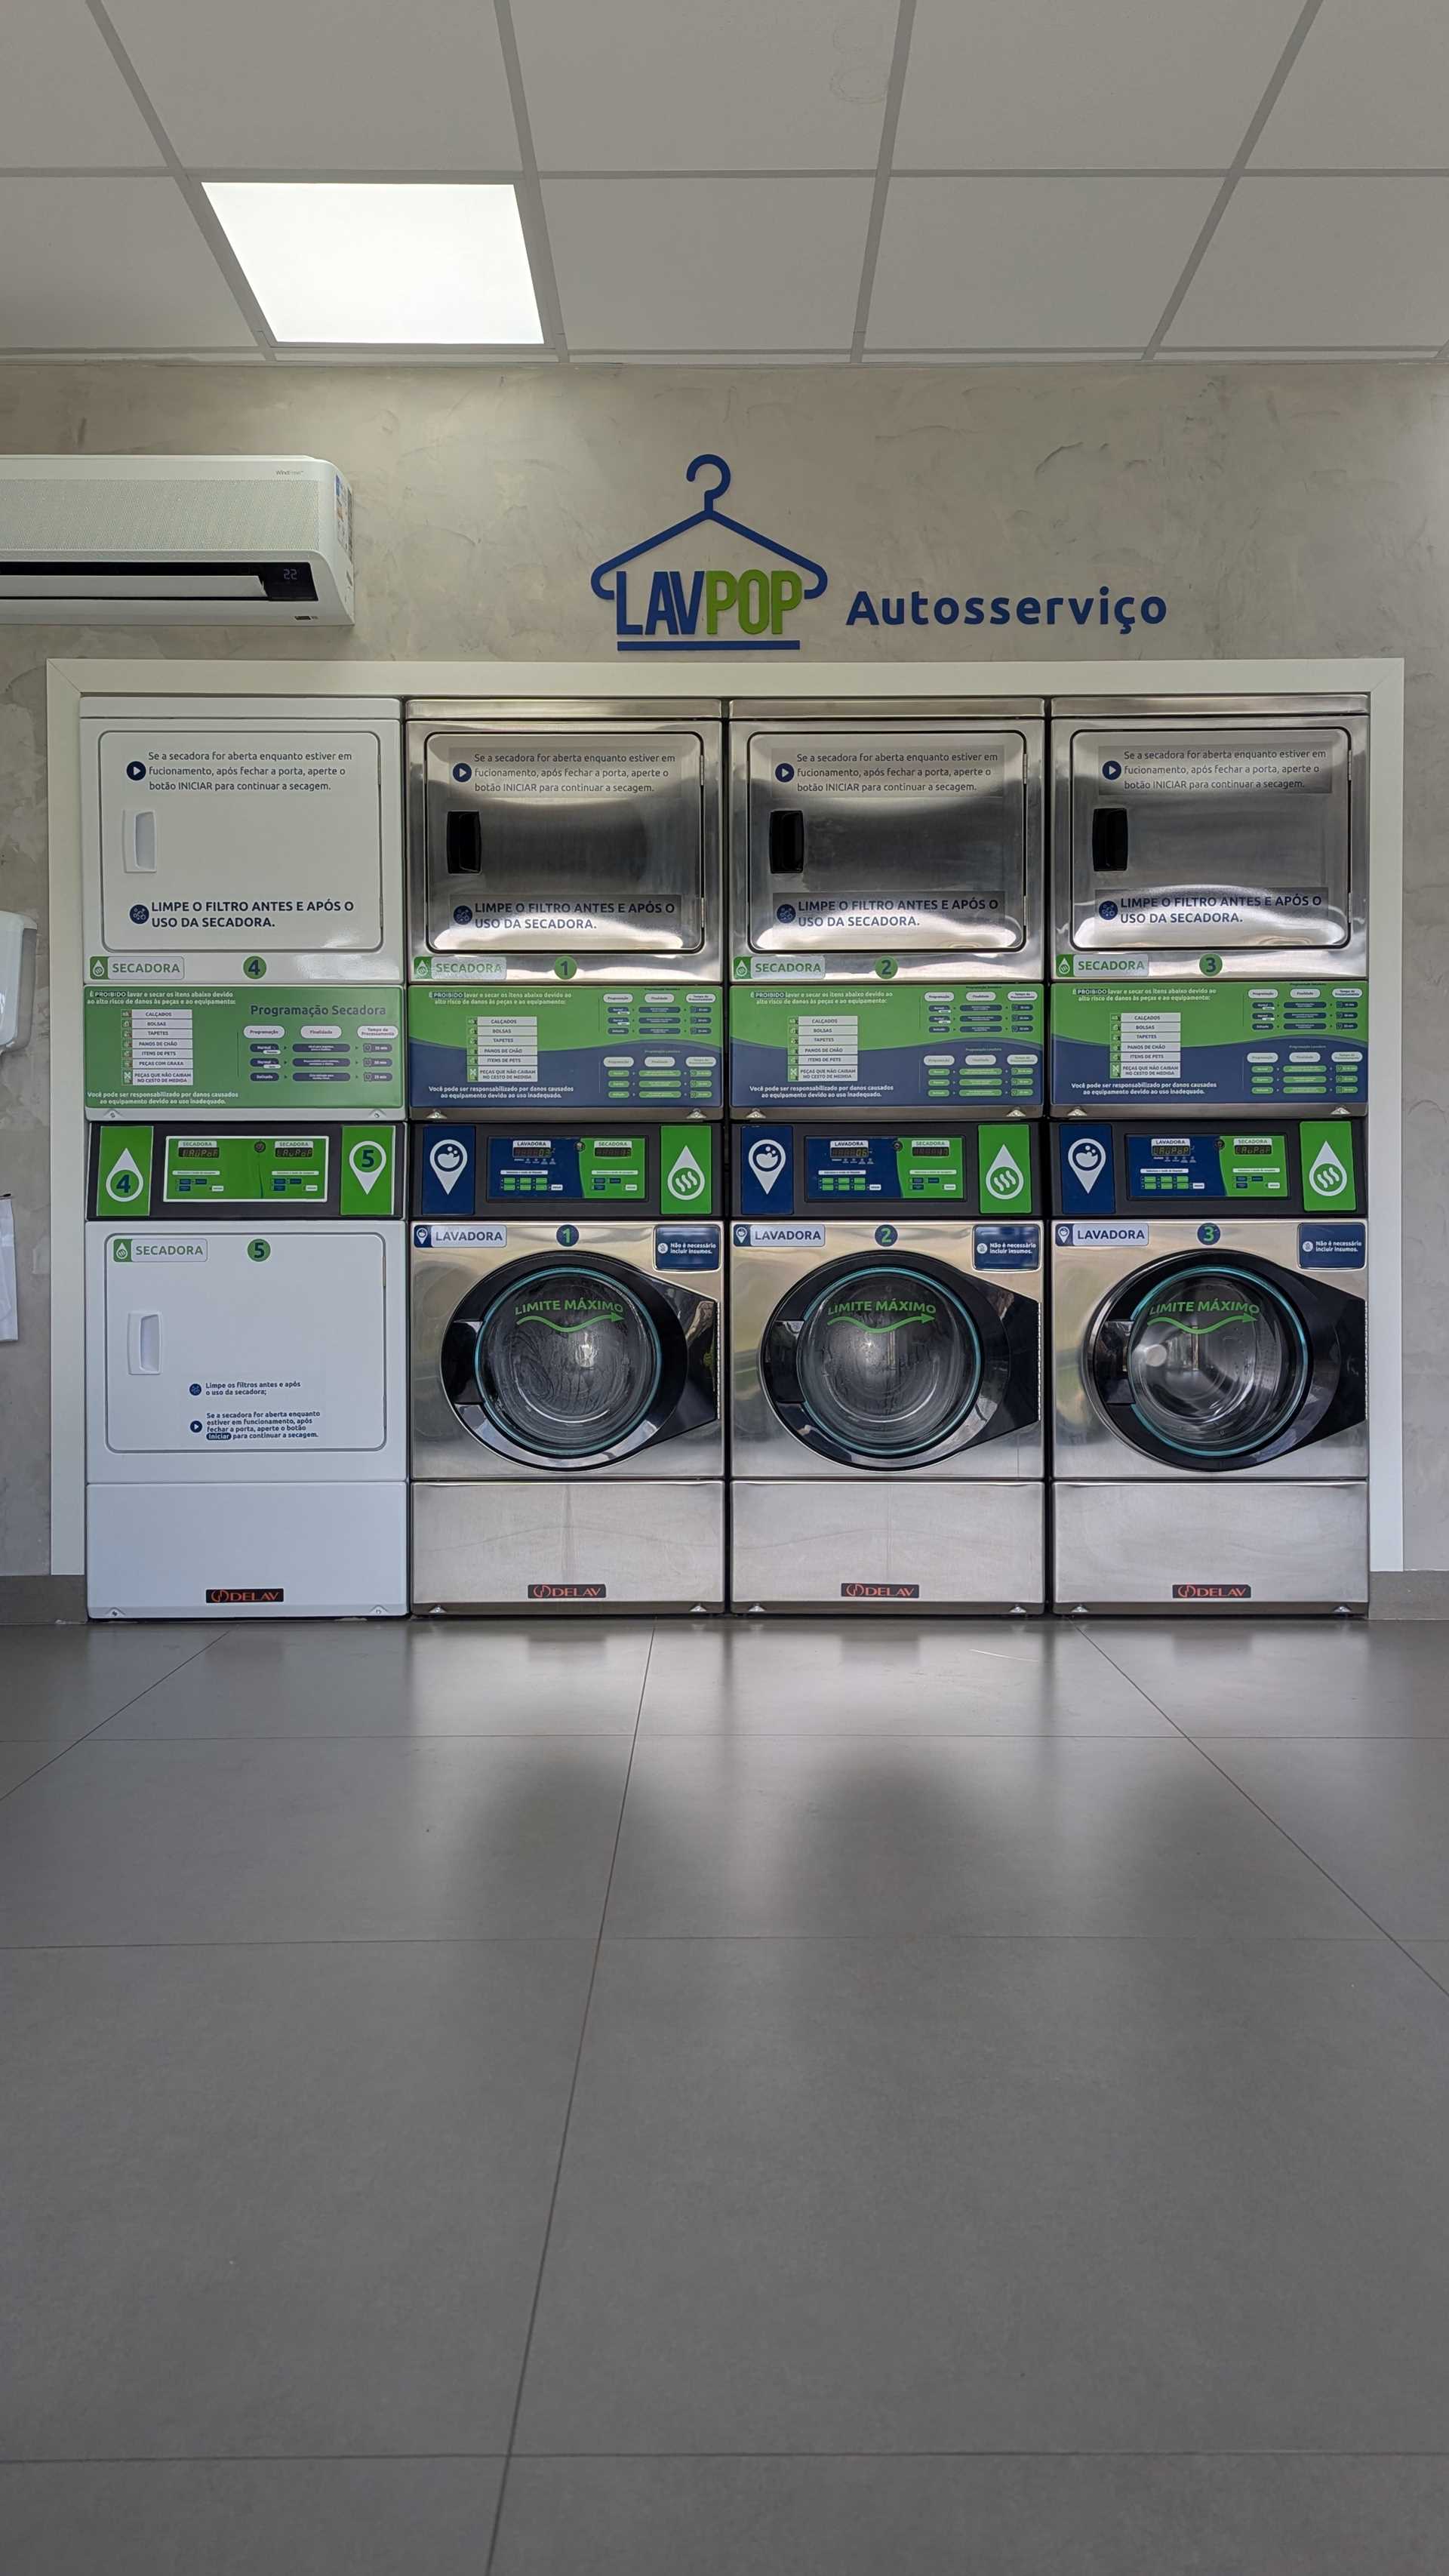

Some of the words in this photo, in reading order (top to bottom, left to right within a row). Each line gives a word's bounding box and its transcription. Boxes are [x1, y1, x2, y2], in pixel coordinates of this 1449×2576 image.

[284, 568, 297, 580] 22
[616, 568, 802, 636] LAVPOP
[845, 586, 1167, 635] Autosserviço
[148, 751, 160, 761] Se
[169, 752, 210, 760] secadora
[213, 751, 226, 760] for
[228, 752, 257, 760] aberta
[260, 752, 303, 762] enquanto
[305, 752, 336, 760] estiver
[797, 753, 808, 762] Se
[817, 753, 857, 762] secadora
[860, 752, 873, 762] for
[875, 753, 904, 762] aberta
[906, 753, 949, 763] enquanto
[952, 752, 982, 761] estiver
[149, 766, 214, 777] fucionamento,
[216, 766, 238, 777] após
[240, 766, 269, 775] fechar
[278, 767, 306, 777] porta,
[308, 767, 337, 777] aperte
[797, 767, 861, 778] fucionamento,
[863, 768, 884, 778] após
[888, 768, 915, 777] fechar
[925, 768, 951, 777] porta,
[954, 767, 983, 777] aperte
[149, 781, 176, 790] botão
[178, 780, 213, 790] INICIAR
[237, 781, 280, 790] continuar
[290, 783, 331, 792] secagem.
[798, 783, 823, 792] botão
[826, 783, 860, 792] INICIAR
[884, 783, 927, 791] continuar
[936, 784, 977, 792] secagem.
[152, 902, 189, 912] LIMPE
[193, 901, 202, 912] O
[206, 901, 248, 912] FILTRO
[252, 901, 293, 912] ANTES
[297, 901, 303, 911] E
[306, 898, 341, 911] APÓS
[344, 901, 354, 911] O
[1121, 898, 1161, 908] LIMPE
[1161, 897, 1171, 907] O
[1174, 897, 1217, 907] FILTRO
[1220, 897, 1261, 906] ANTES
[1264, 896, 1272, 906] E
[1275, 894, 1309, 906] APÓS
[1312, 896, 1322, 906] O
[152, 918, 177, 928] USO
[181, 918, 199, 928] DA
[202, 917, 275, 928] SECADORA.
[1121, 913, 1146, 923] USO
[1150, 913, 1167, 923] DA
[1171, 913, 1243, 923] SECADORA.
[112, 963, 180, 973] SECADORA
[248, 959, 260, 975] 4
[435, 963, 503, 973] SECADORA
[560, 961, 568, 975] 1
[755, 963, 821, 973] SECADORA
[881, 959, 891, 974] 2
[1078, 961, 1145, 970] SECADORA
[1206, 958, 1216, 972] 3
[251, 1005, 328, 1017] Programação
[332, 1005, 386, 1015] Secadora
[361, 1150, 374, 1168] 5
[116, 1174, 131, 1193] 4
[435, 1232, 503, 1241] LAVADORA
[562, 1228, 571, 1243] 1
[755, 1231, 821, 1240] LAVADORA
[881, 1228, 892, 1243] 2
[1078, 1230, 1145, 1239] LAVADORA
[1203, 1226, 1214, 1242] 3
[135, 1245, 203, 1255] SECADORA
[254, 1242, 265, 1258] 5
[515, 1300, 561, 1316] LIMITE
[565, 1297, 623, 1313] MÁXIMO
[827, 1301, 872, 1316] LIMITE
[875, 1298, 937, 1314] MÁXIMO
[1149, 1301, 1195, 1316] LIMITE
[1198, 1298, 1260, 1314] MÁXIMO
[237, 1381, 257, 1390] filtros
[230, 1592, 279, 1601] DELAV
[552, 1587, 601, 1596] DELAV
[865, 1587, 915, 1596] DELAV
[1197, 1587, 1246, 1597] DELAV
